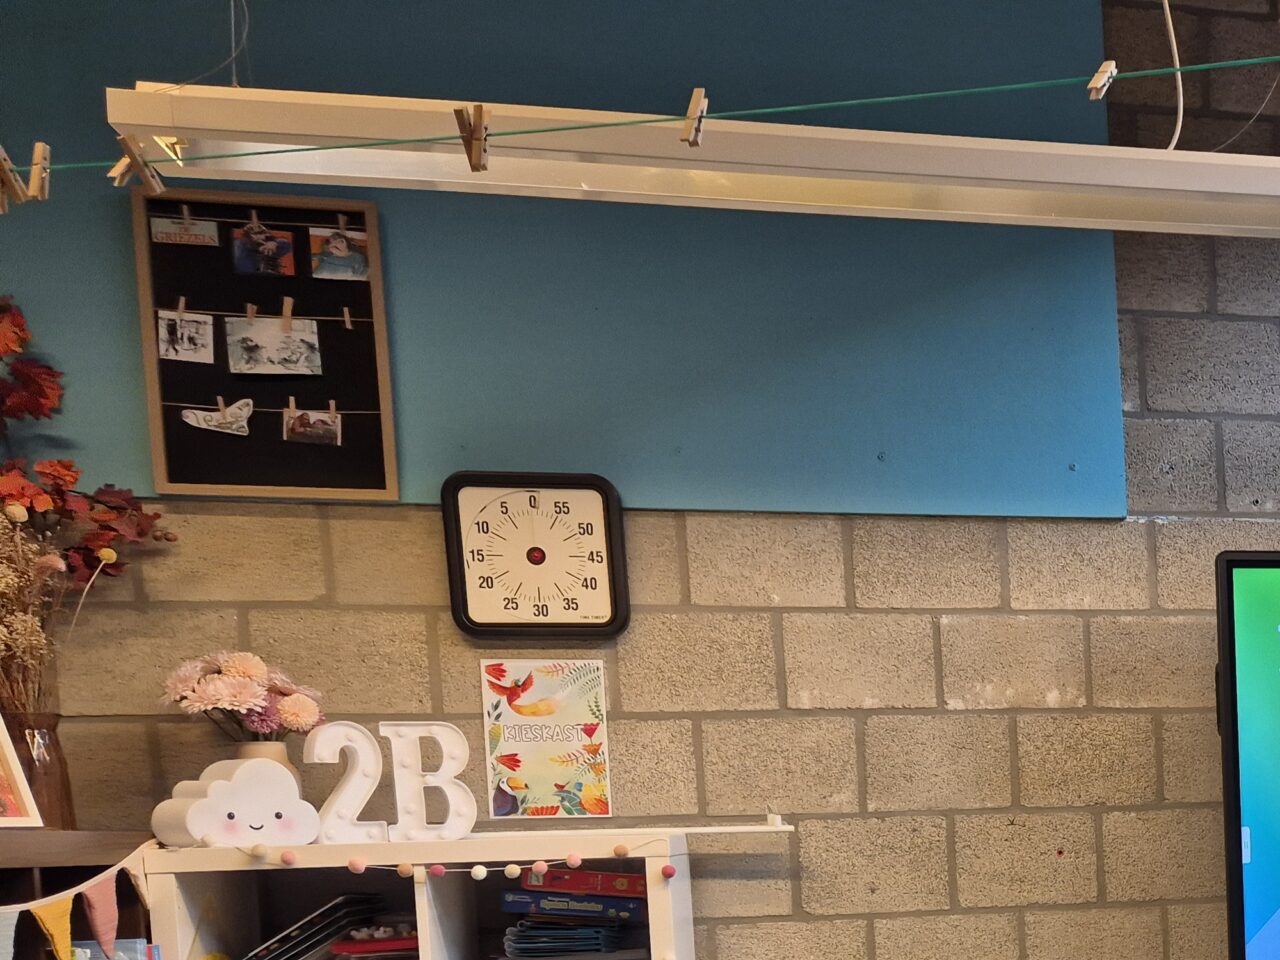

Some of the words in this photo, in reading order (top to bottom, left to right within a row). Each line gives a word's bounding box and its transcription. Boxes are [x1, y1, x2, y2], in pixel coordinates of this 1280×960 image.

[529, 495, 536, 508] 0
[554, 501, 570, 515] 55
[501, 502, 508, 515] 5
[475, 521, 489, 534] 10
[578, 523, 593, 535] 50
[469, 549, 485, 562] 15
[587, 551, 603, 563] 45
[479, 576, 494, 589] 20
[581, 577, 597, 590] 40
[503, 598, 518, 610] 25
[563, 598, 579, 611] 35
[533, 605, 549, 617] 30
[503, 723, 584, 742] KIESKAST
[303, 720, 477, 842] 2B
